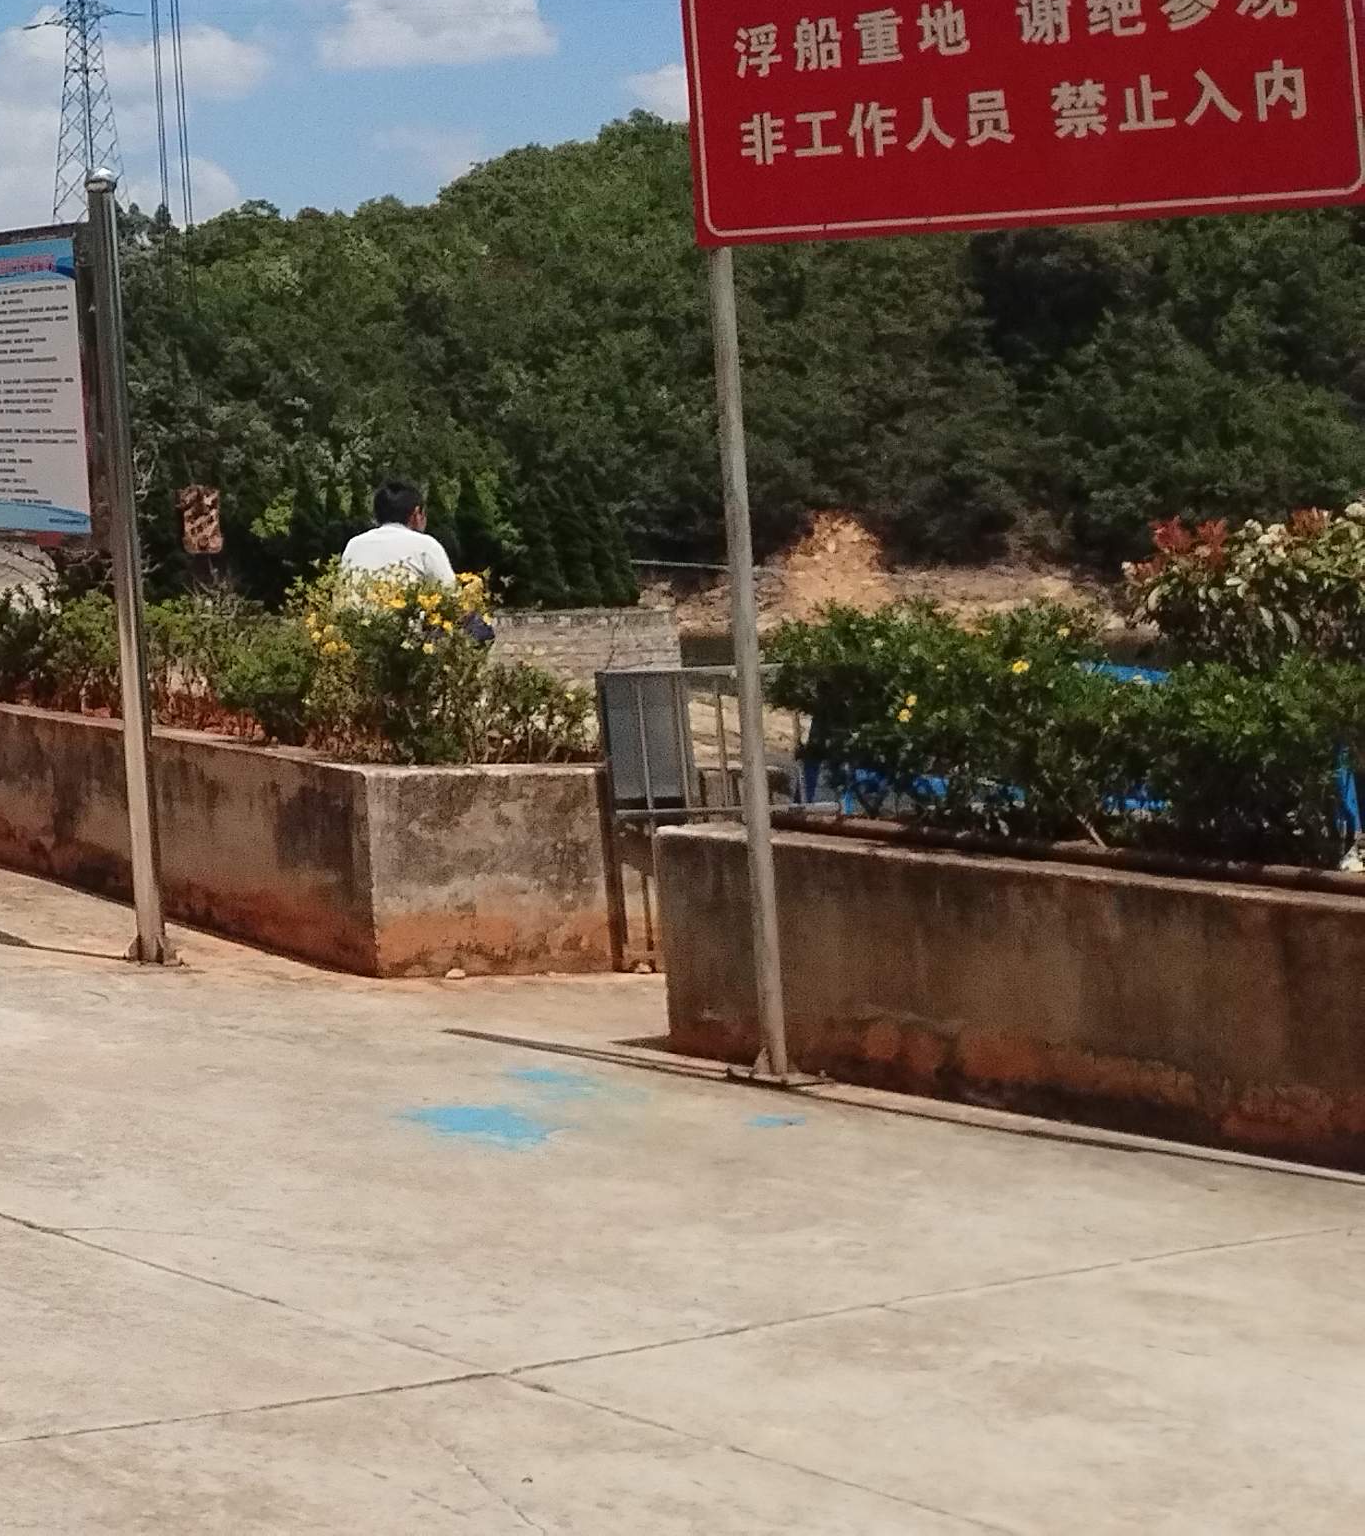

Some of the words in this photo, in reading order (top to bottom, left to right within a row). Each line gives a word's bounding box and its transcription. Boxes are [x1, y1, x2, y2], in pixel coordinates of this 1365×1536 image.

[734, 0, 970, 78] 浮船重地
[740, 89, 1015, 166] 非工作人员
[1050, 59, 1307, 140] 禁止入内
